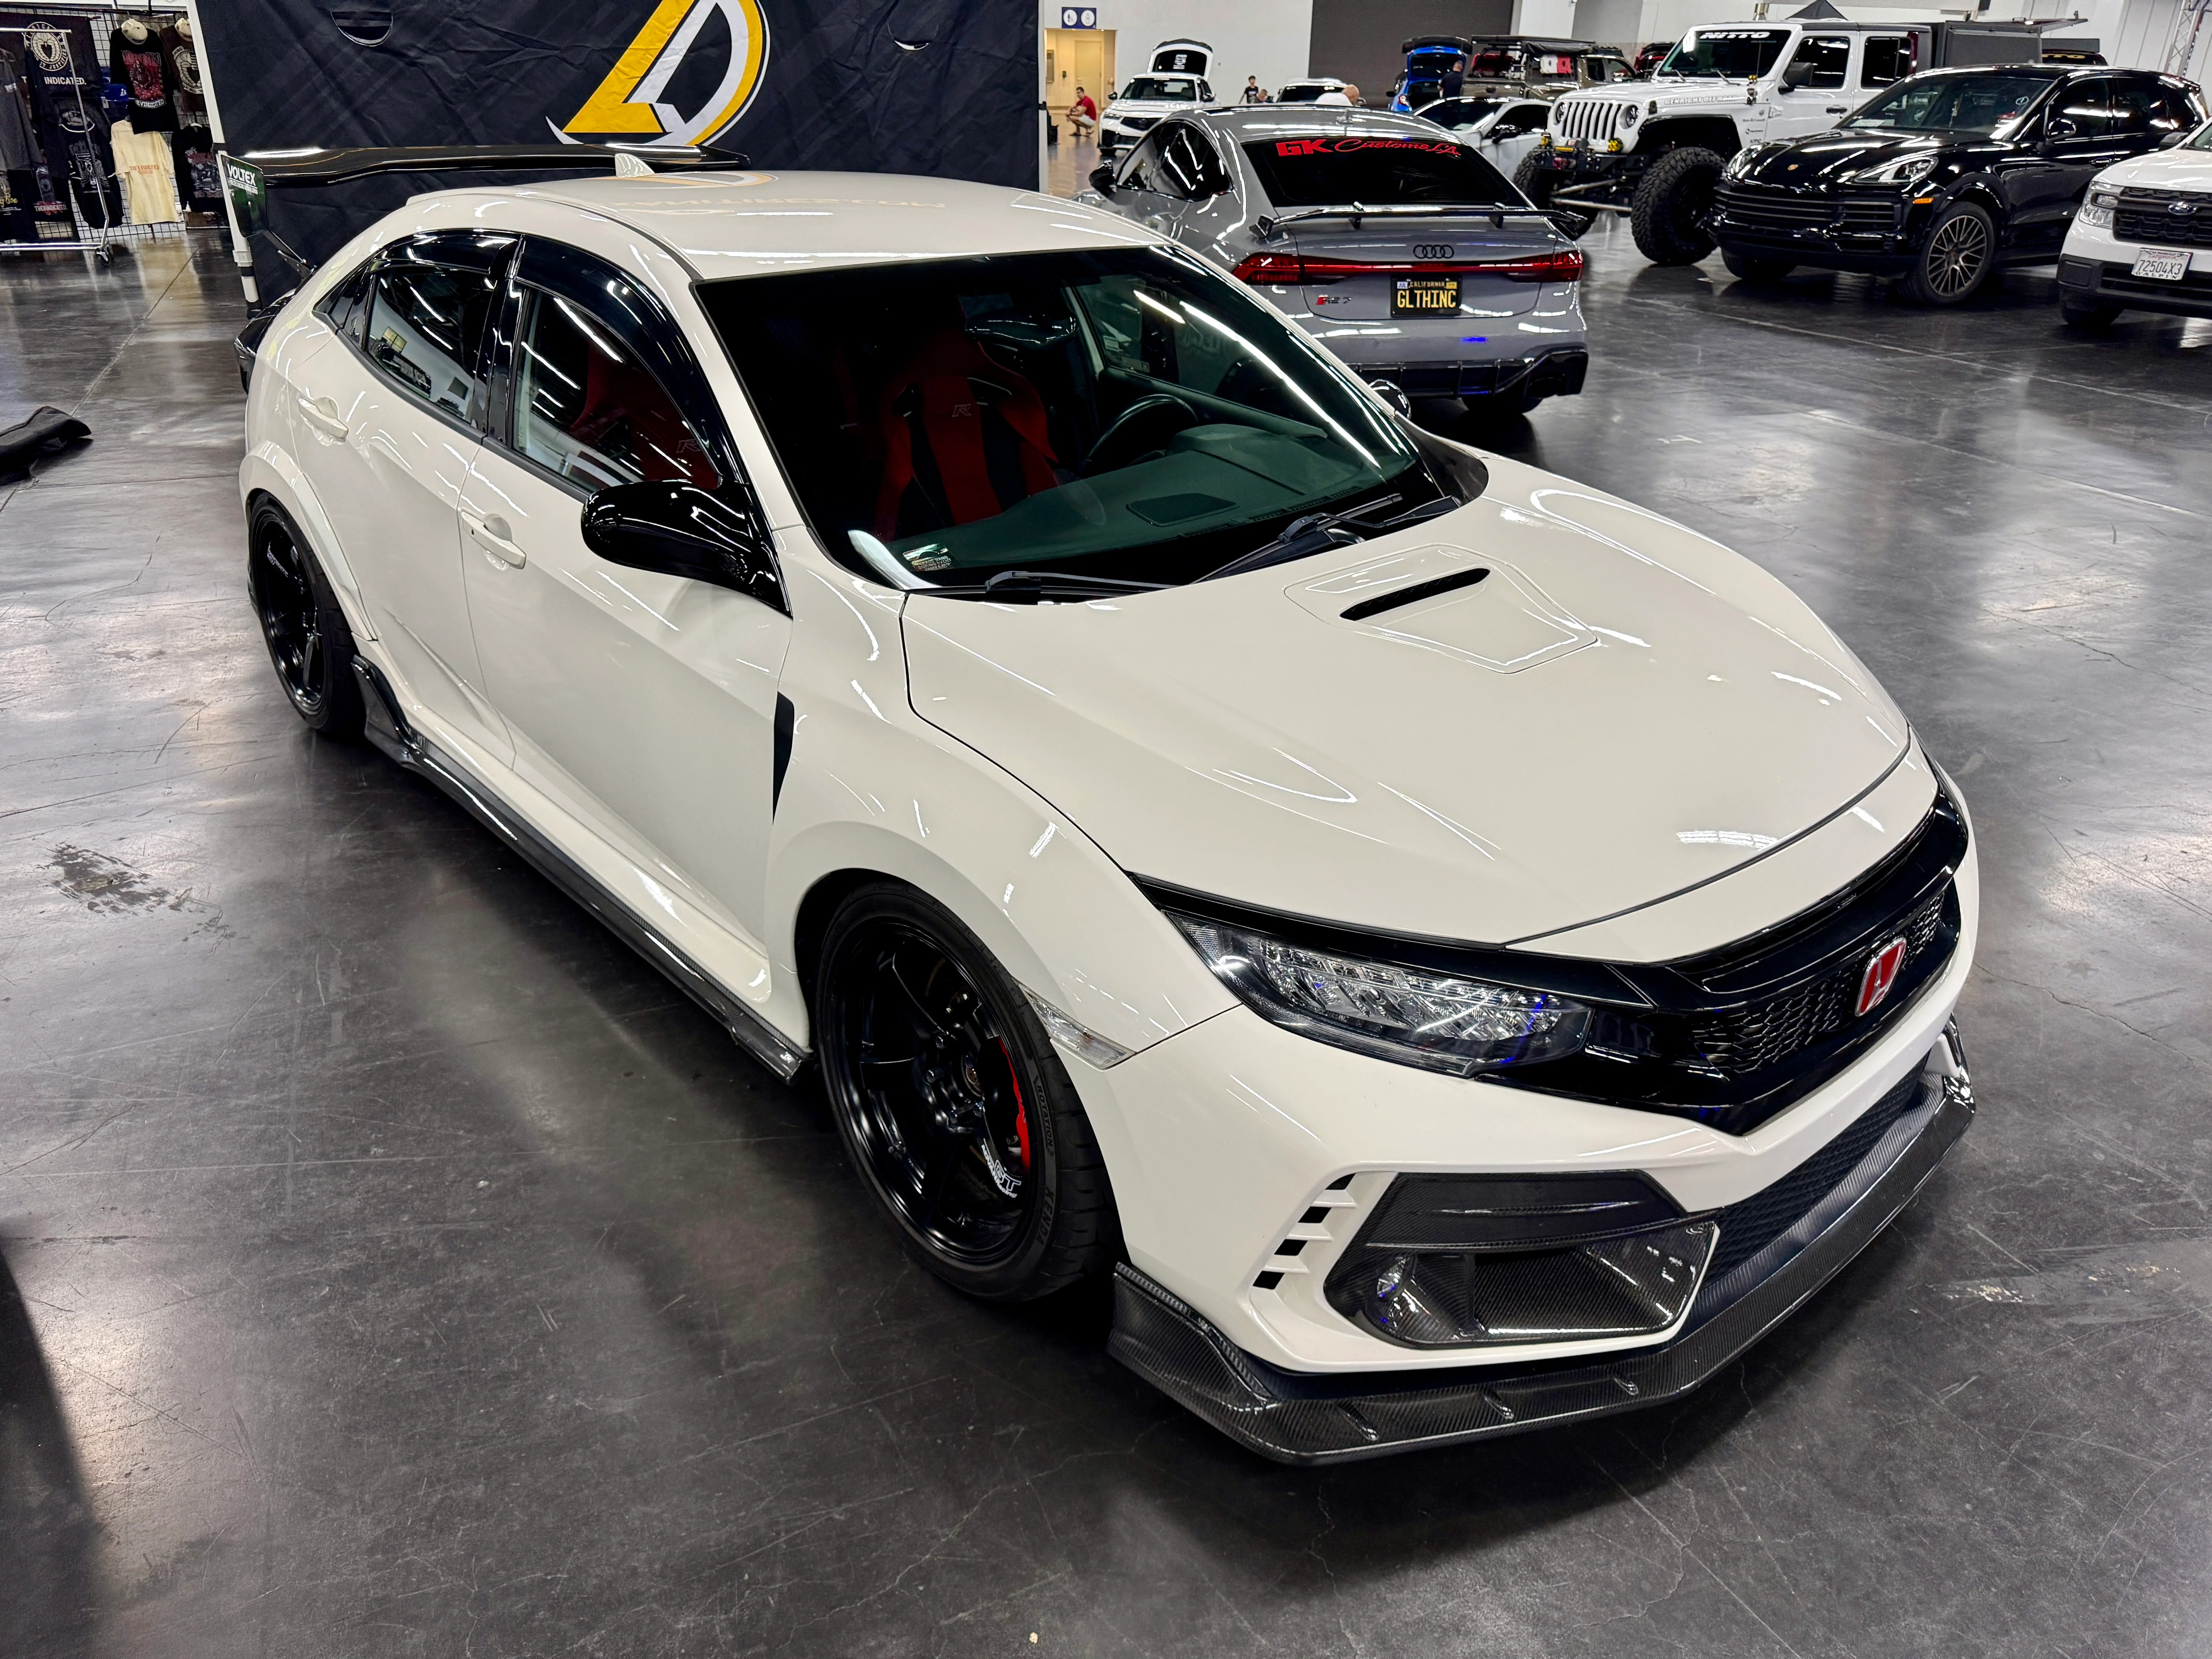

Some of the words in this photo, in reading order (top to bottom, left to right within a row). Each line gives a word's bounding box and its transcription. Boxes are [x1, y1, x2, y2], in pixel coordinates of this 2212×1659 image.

[1276, 139, 1334, 156] GK
[1334, 139, 1428, 152] Customs
[227, 163, 256, 186] VOLTEX
[2138, 260, 2183, 275] 72504X3
[1397, 290, 1456, 308] GLTHINC
[1037, 1085, 1053, 1147] ROTATION
[994, 1159, 1022, 1192] GT
[1036, 1186, 1054, 1246] KENDA
